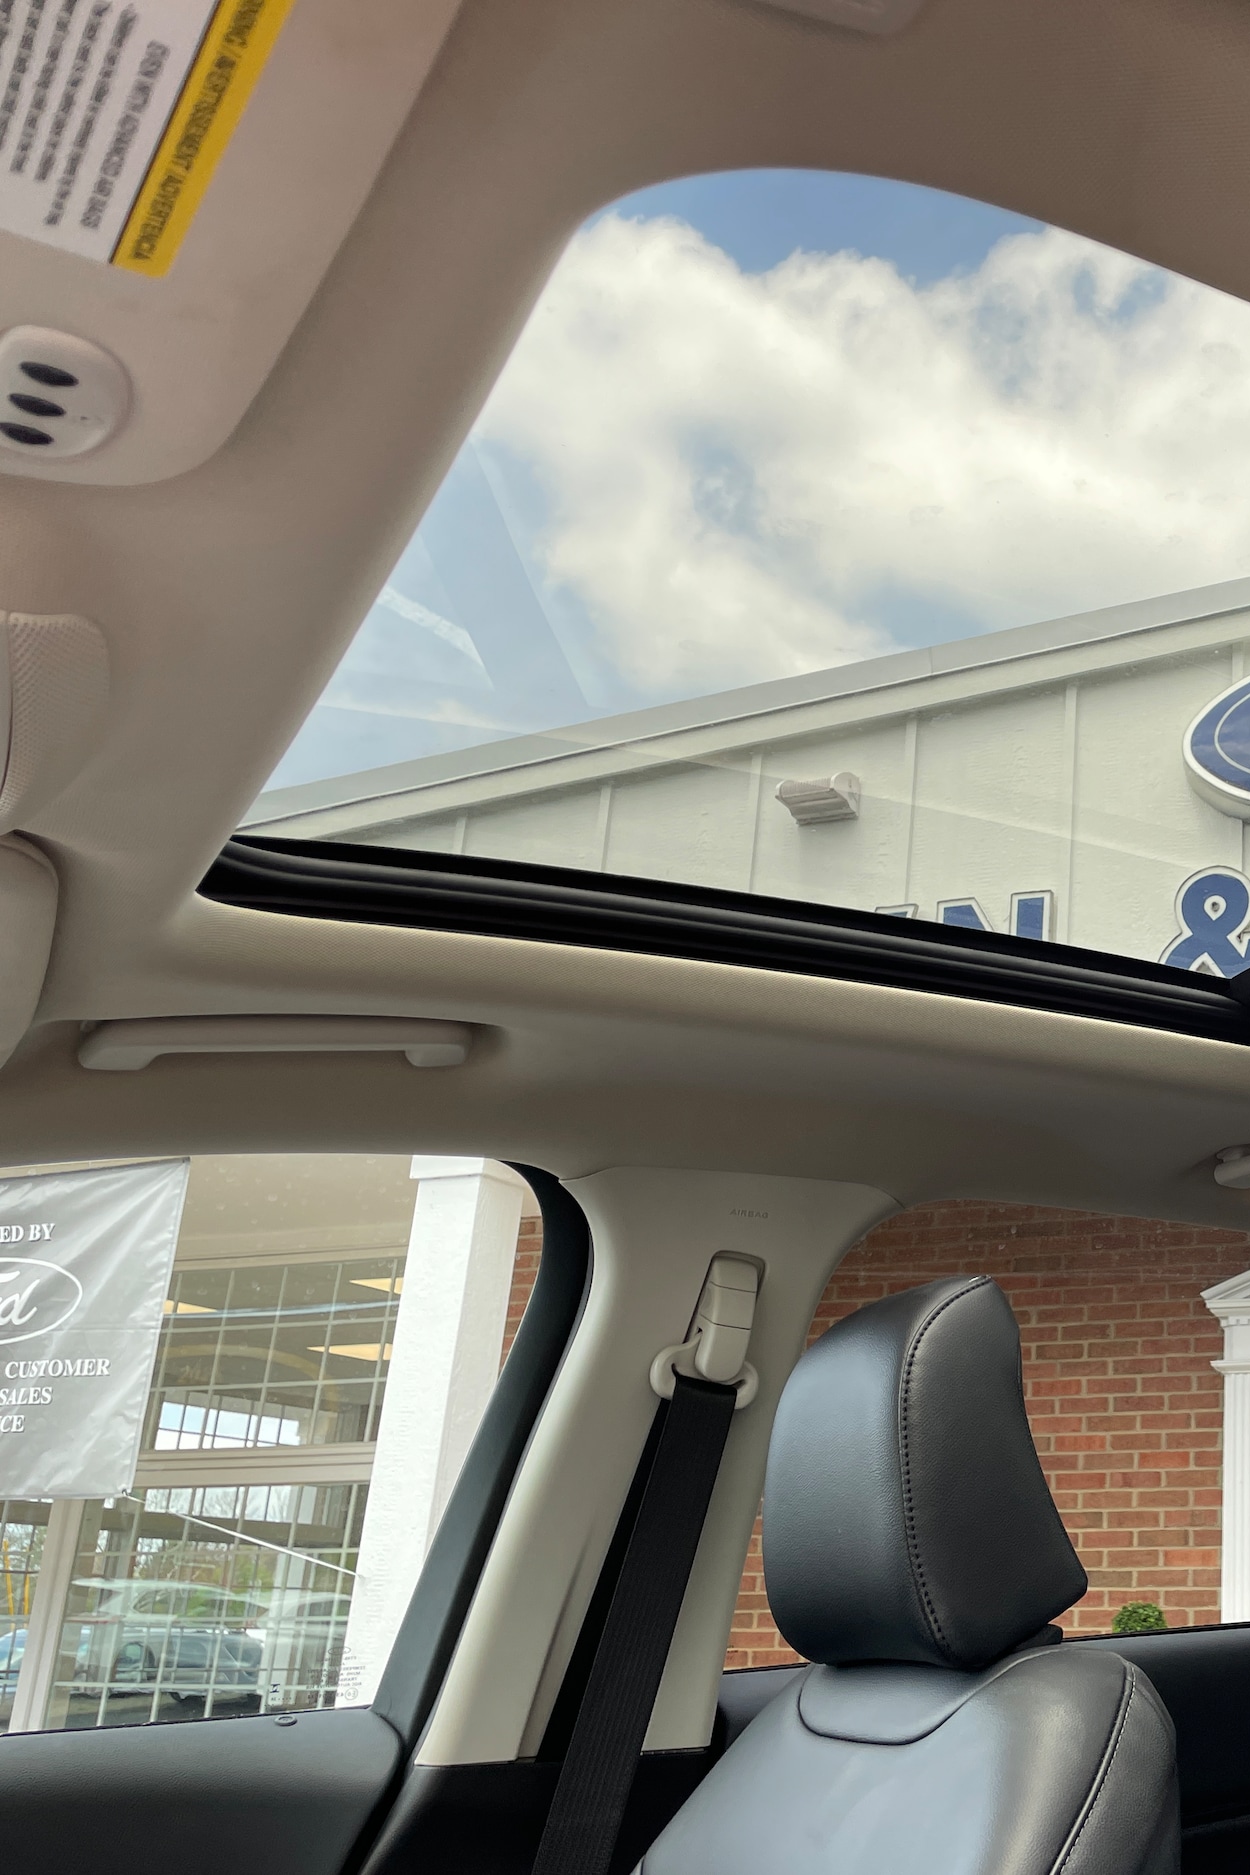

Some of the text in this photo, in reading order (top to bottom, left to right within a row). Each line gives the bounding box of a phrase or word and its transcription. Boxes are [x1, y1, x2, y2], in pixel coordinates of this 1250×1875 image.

[728, 1208, 769, 1219] AIRBAG
[28, 1223, 56, 1241] BY
[5, 1358, 111, 1379] CUSTOMER
[0, 1386, 53, 1406] SALES
[0, 1414, 25, 1433] CE
